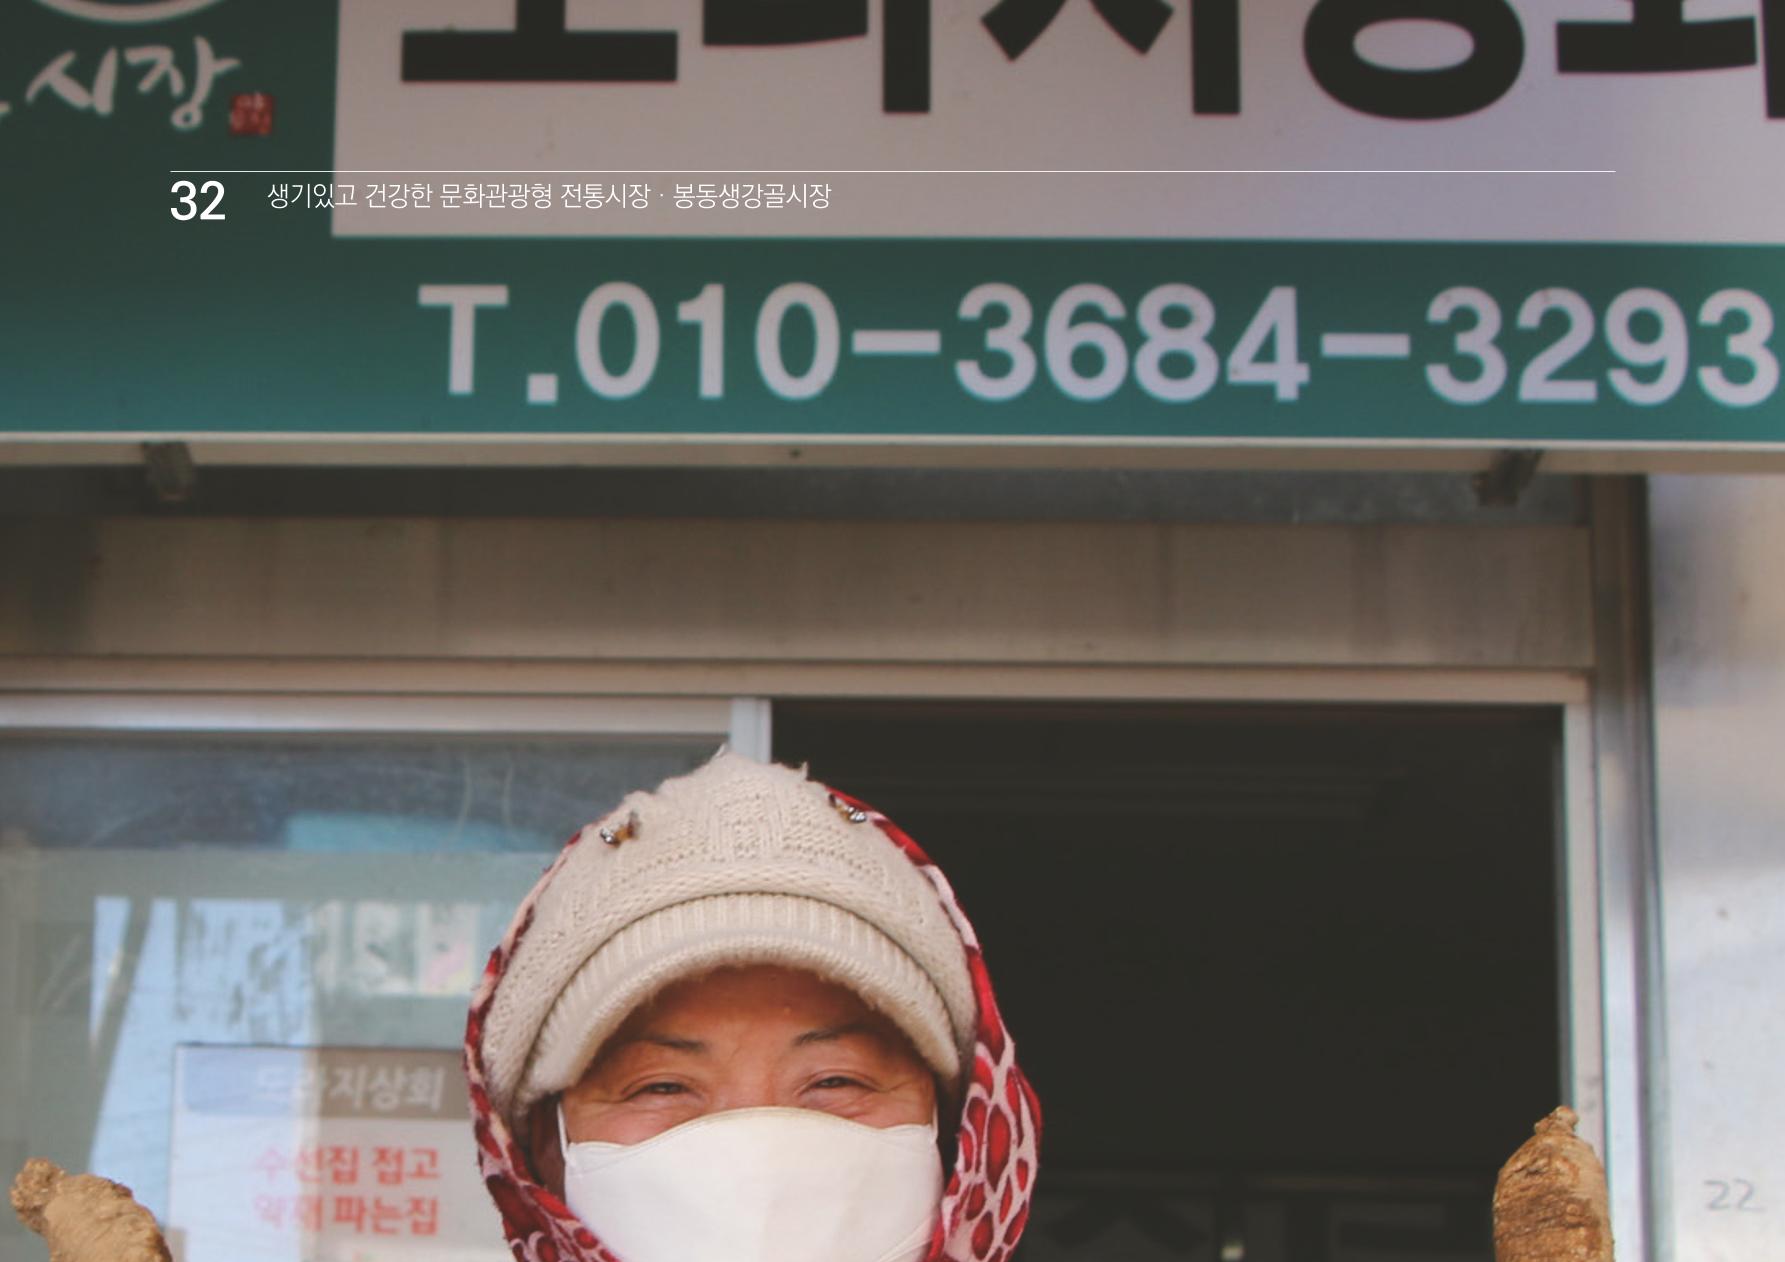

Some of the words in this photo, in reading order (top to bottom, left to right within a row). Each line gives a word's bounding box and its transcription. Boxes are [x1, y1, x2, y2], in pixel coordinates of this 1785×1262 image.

[418, 281, 1781, 407] T.010-3684-3293
[372, 1145, 442, 1186] 접고
[1703, 1177, 1766, 1213] 22
